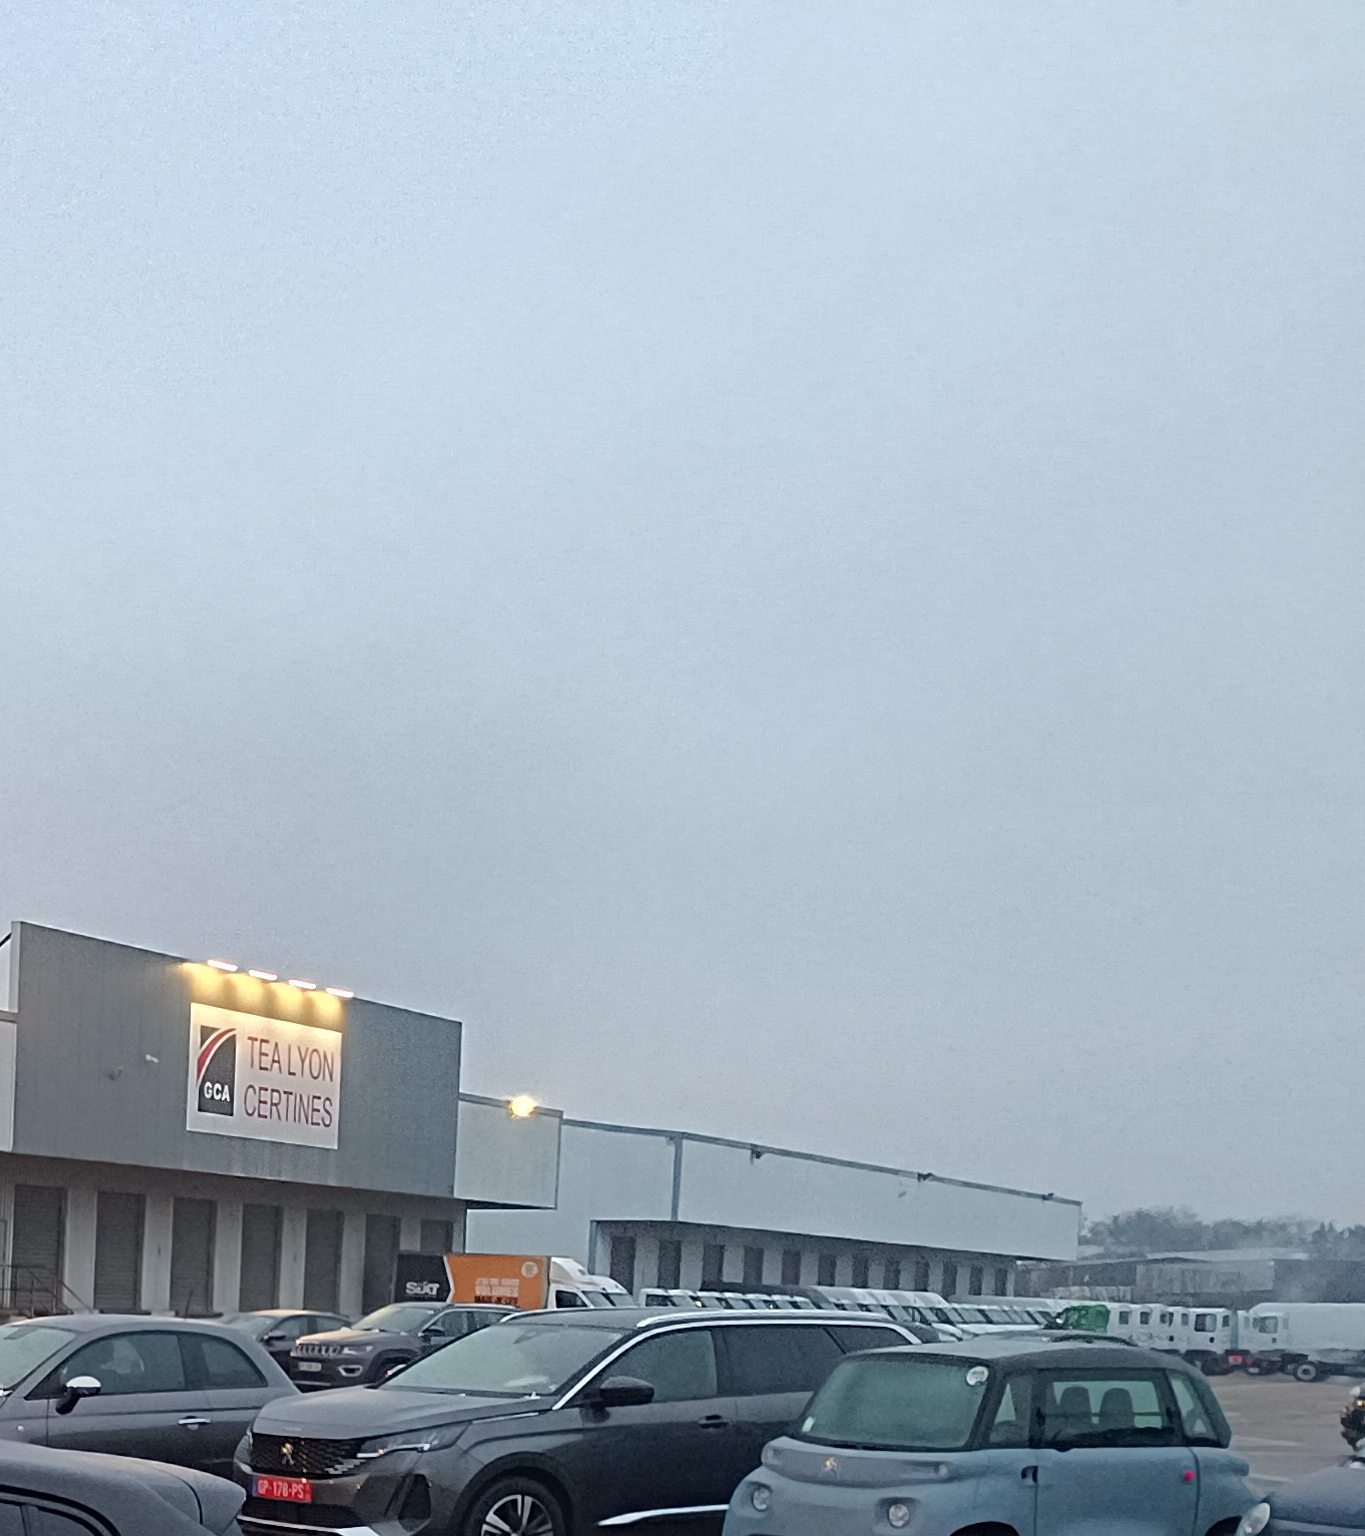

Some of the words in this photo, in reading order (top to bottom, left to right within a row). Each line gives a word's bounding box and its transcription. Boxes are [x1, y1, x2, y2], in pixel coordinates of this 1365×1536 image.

[247, 1035, 282, 1075] TEA
[287, 1042, 335, 1083] LYON
[203, 1081, 231, 1102] GCA
[243, 1084, 333, 1128] CERTINES
